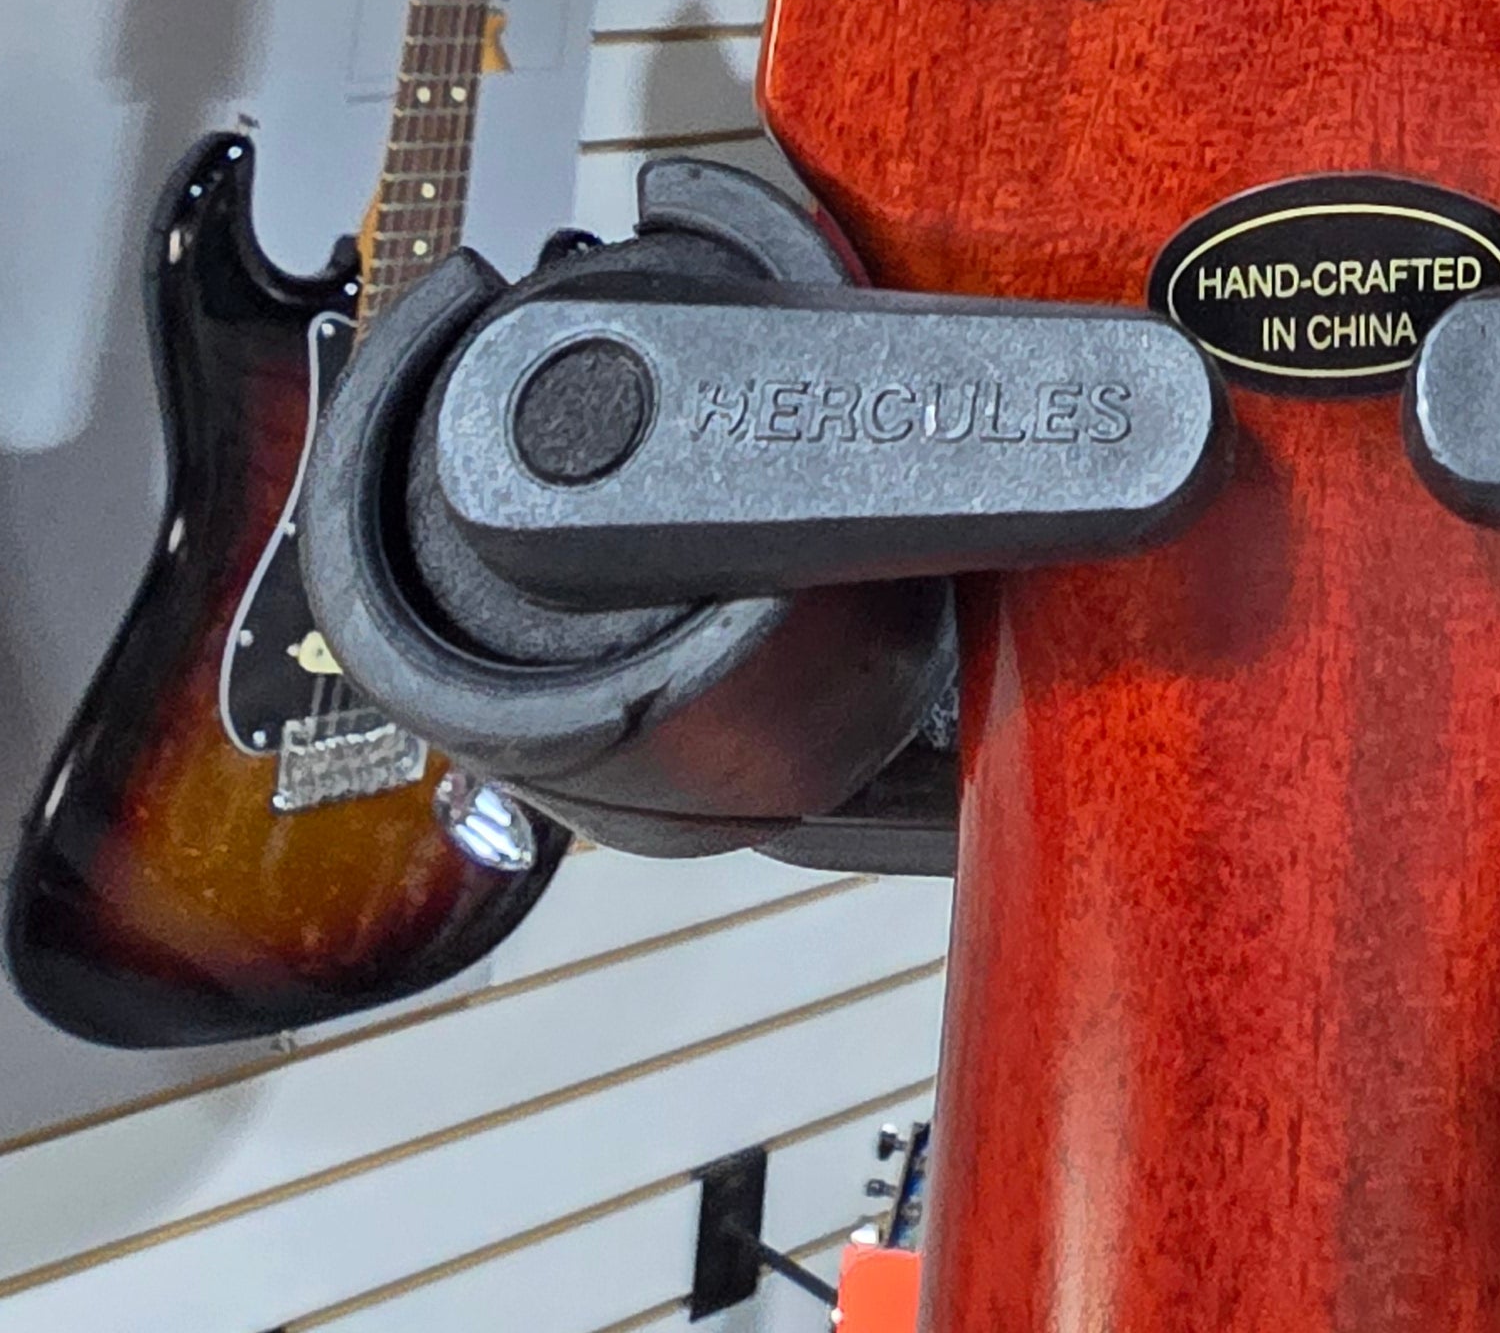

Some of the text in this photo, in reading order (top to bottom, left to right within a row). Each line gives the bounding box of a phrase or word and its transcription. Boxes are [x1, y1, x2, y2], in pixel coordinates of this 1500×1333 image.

[1198, 256, 1483, 301] HAND-CRAFTED
[1262, 311, 1418, 351] IN CHINA
[692, 378, 1133, 443] HERCULES
